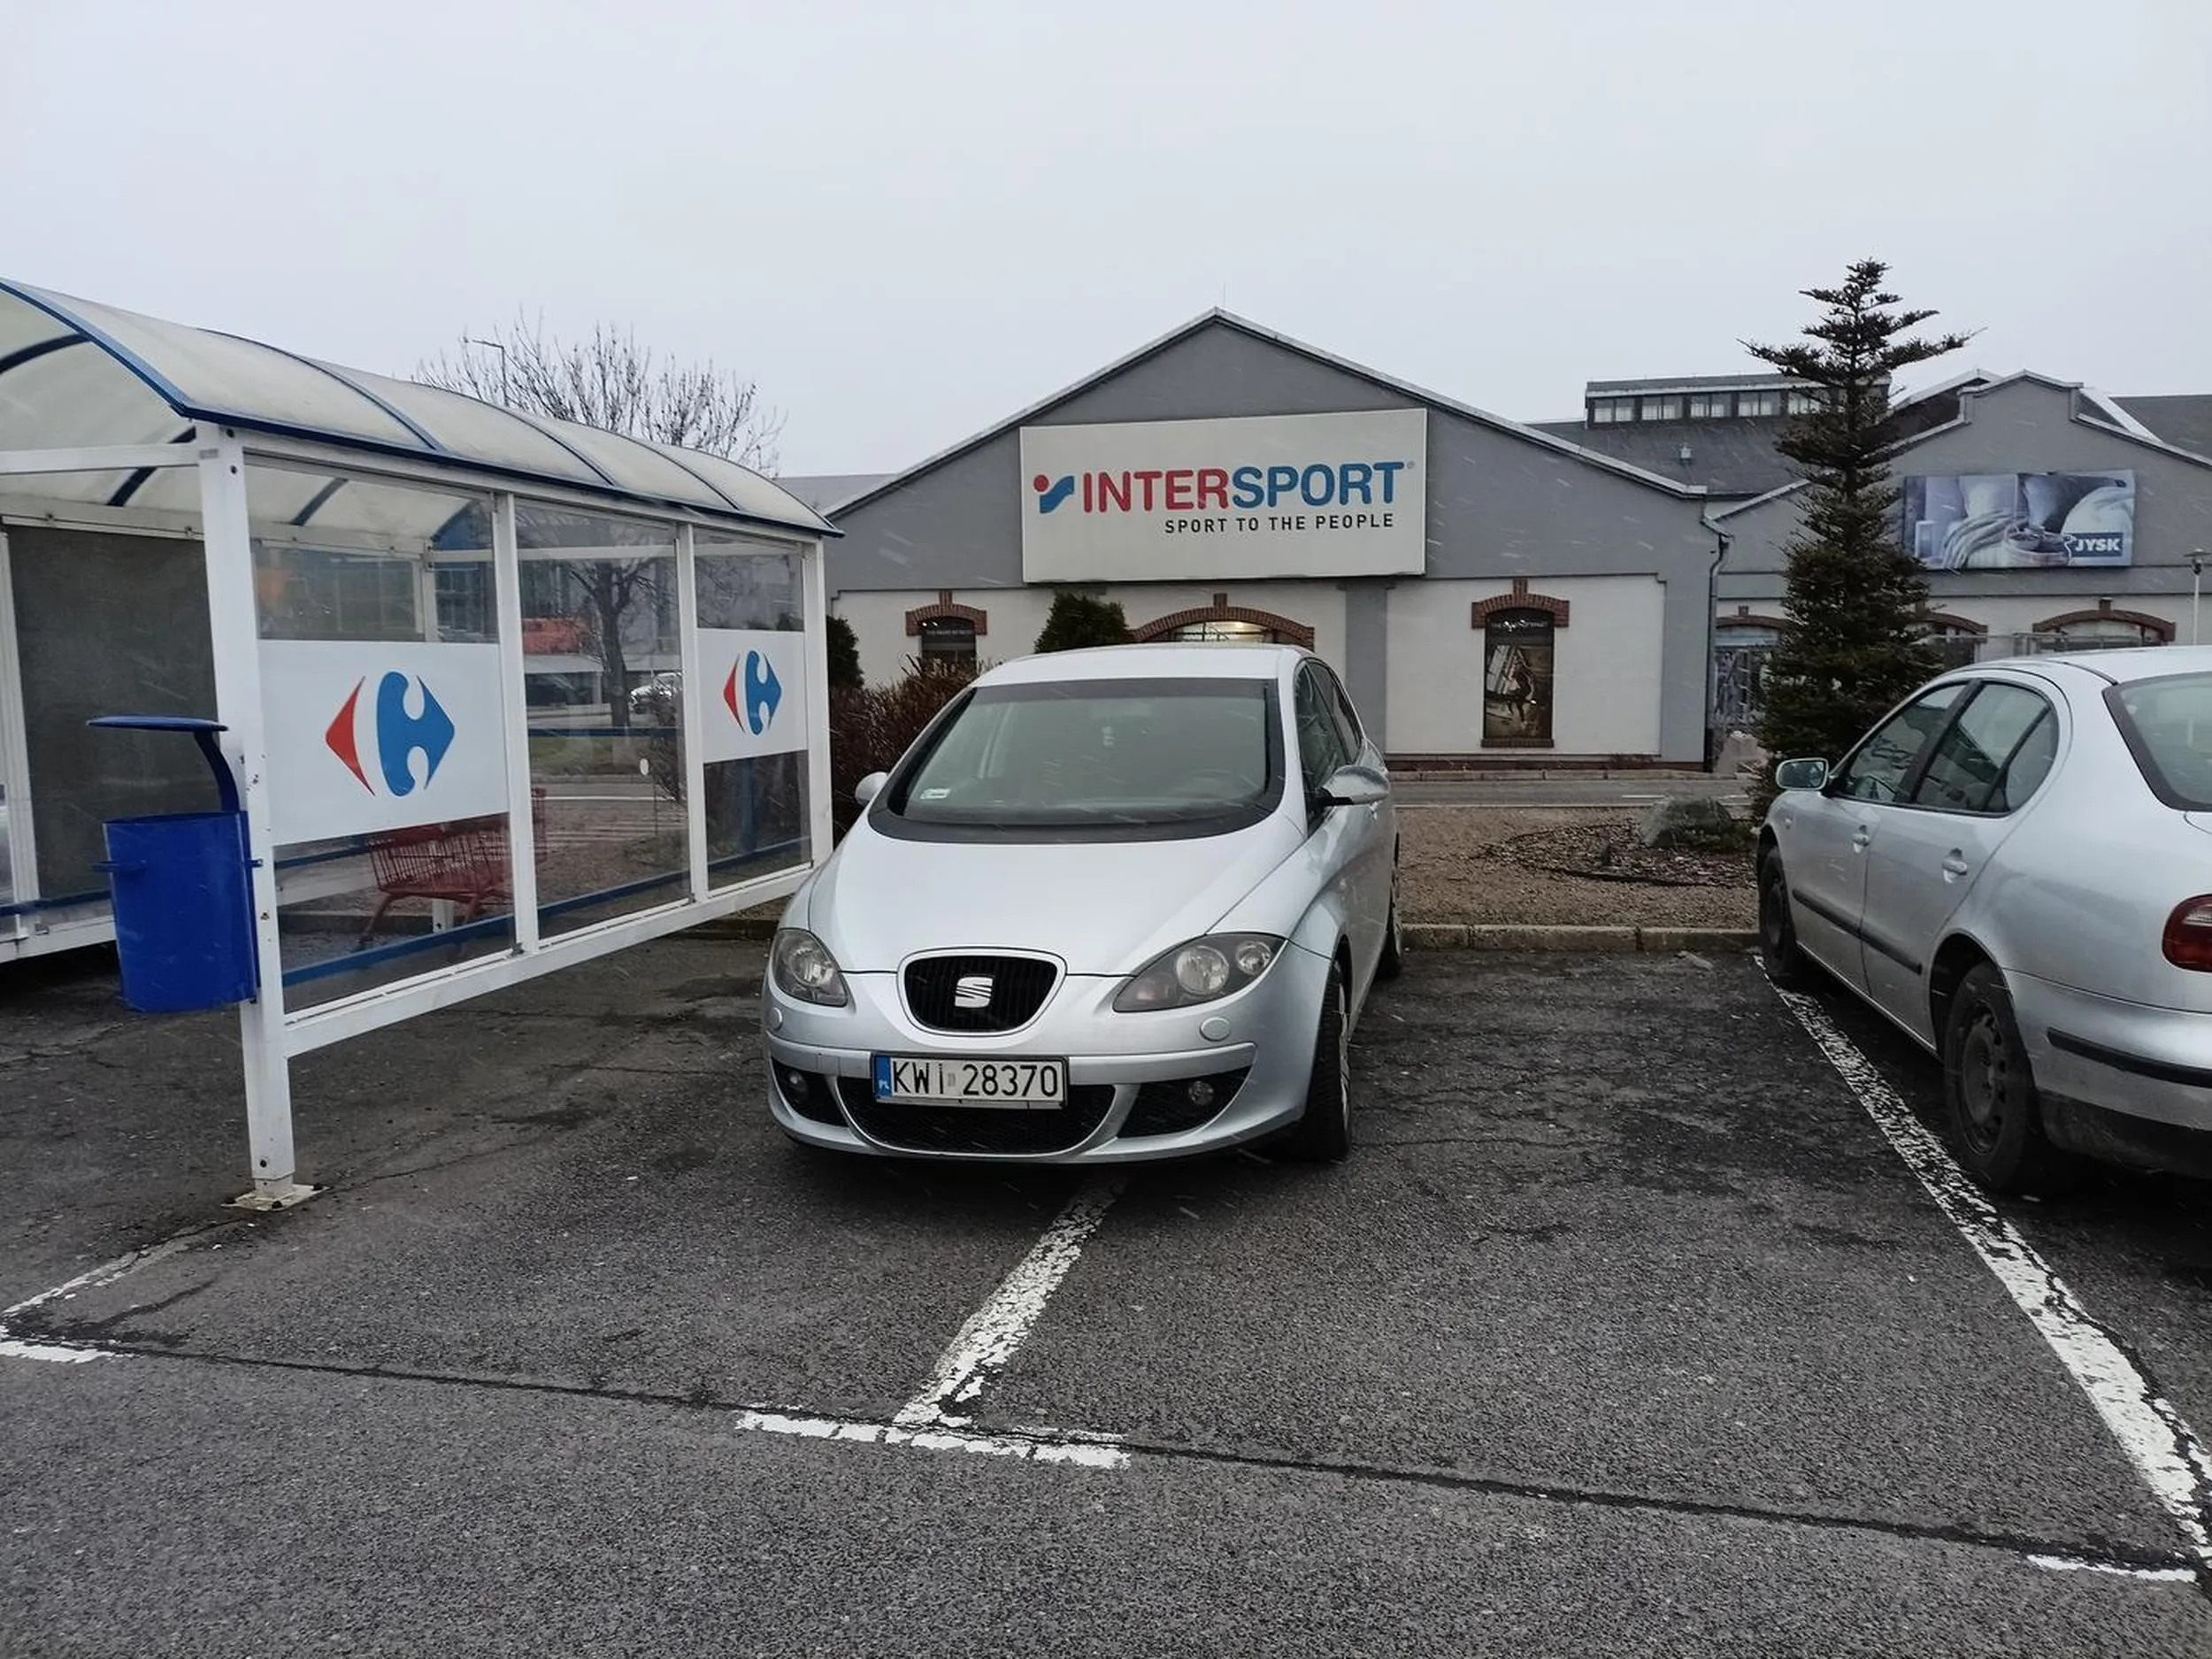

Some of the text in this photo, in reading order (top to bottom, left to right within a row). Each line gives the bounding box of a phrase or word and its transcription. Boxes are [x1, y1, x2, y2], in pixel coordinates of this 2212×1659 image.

[1082, 461, 1405, 513] INTERSPORT
[1164, 513, 1394, 534] SPORT TO THE PEOPLE
[2076, 538, 2120, 551] JYSK
[963, 1064, 1058, 1096] 28370
